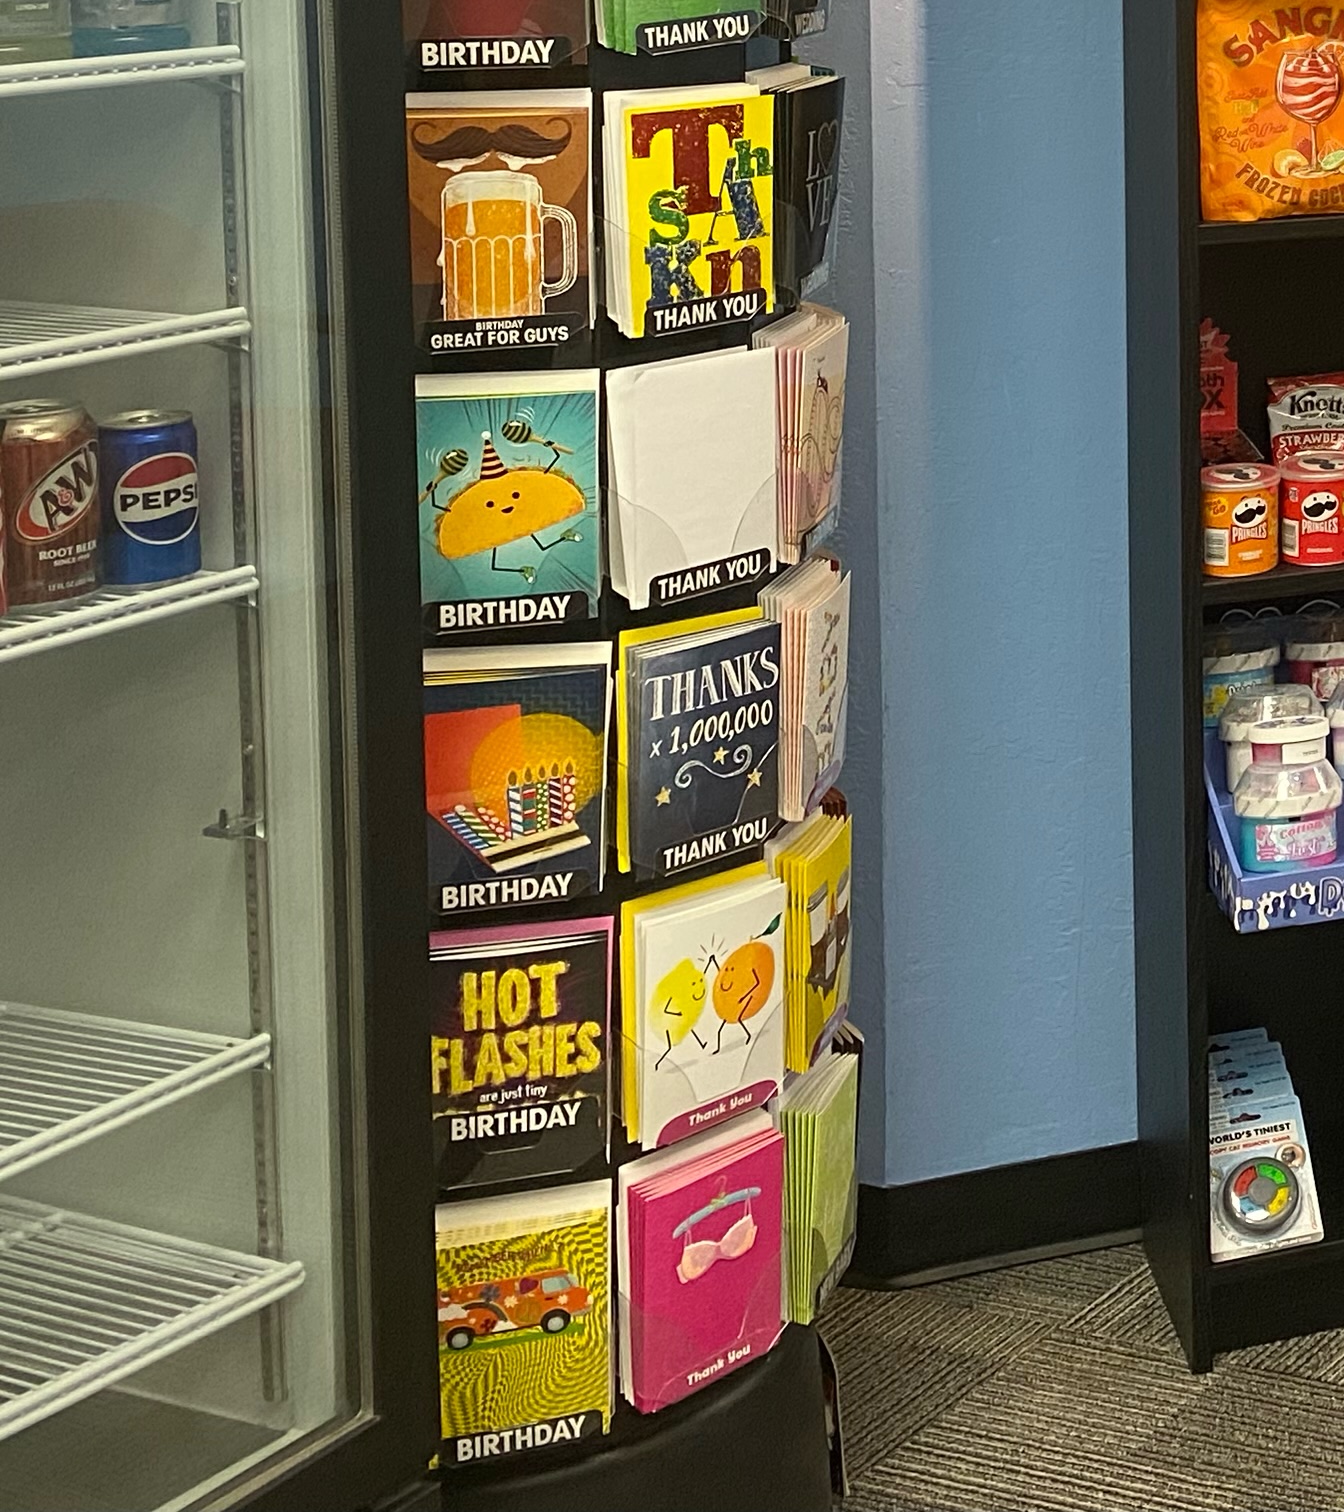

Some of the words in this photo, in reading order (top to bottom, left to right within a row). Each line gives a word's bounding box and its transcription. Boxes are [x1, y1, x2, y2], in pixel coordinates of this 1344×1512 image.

[644, 19, 703, 49] THANK
[708, 15, 750, 40] YOU
[422, 39, 554, 66] BIRTHDAY
[1235, 163, 1299, 207] FROZEN
[475, 320, 524, 331] BIRTHDAY
[653, 299, 717, 331] THANK
[723, 293, 758, 318] YOU
[431, 332, 479, 349] GREAT
[484, 330, 515, 346] FOR
[521, 325, 569, 343] GUYS
[120, 483, 197, 511] PEPSI
[1232, 522, 1267, 542] PRINGLES
[1302, 517, 1339, 534] PRINGLES
[658, 564, 721, 600] THANK
[726, 555, 762, 580] YOU
[439, 596, 570, 628] BIRTHDAY
[645, 646, 779, 721] THANKS
[669, 699, 774, 756] 1,000,000
[664, 831, 725, 870] THANK
[729, 818, 767, 847] YOU
[442, 873, 573, 909] BIRTHDAY
[463, 961, 569, 1032] HOT
[432, 1022, 601, 1095] FLASHES
[451, 1103, 581, 1142] BIRTHDAY
[688, 1097, 729, 1127] Thank
[732, 1091, 752, 1108] You
[1254, 1123, 1291, 1136] TINIEST
[687, 1358, 727, 1387] Thank
[729, 1343, 751, 1364] You
[456, 1415, 586, 1462] BIRTHDAY
